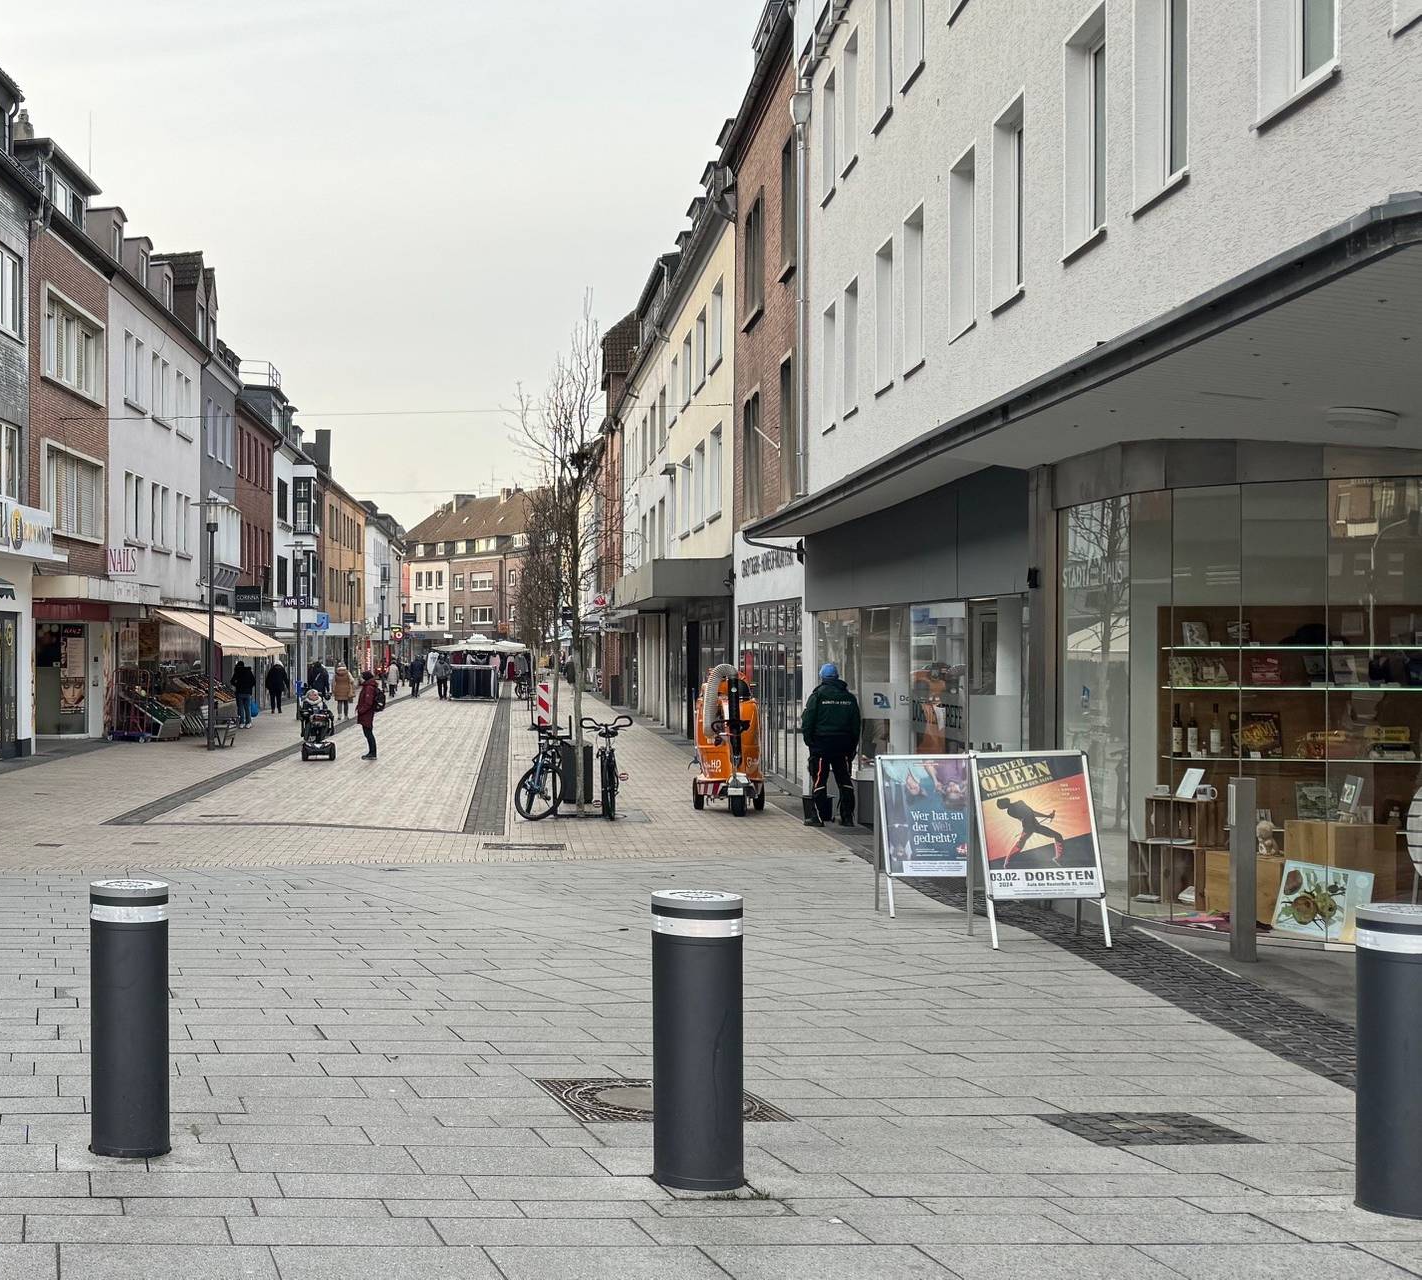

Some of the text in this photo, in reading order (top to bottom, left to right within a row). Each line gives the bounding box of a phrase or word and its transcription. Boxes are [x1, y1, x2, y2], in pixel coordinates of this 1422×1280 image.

[978, 758, 1025, 778] FOREVER
[980, 760, 1052, 792] QUEEN
[910, 810, 963, 821] Wer hat an
[912, 821, 951, 832] der Welt
[913, 833, 957, 845] gedreht?
[990, 870, 1095, 882] 03.02. DORSTEN
